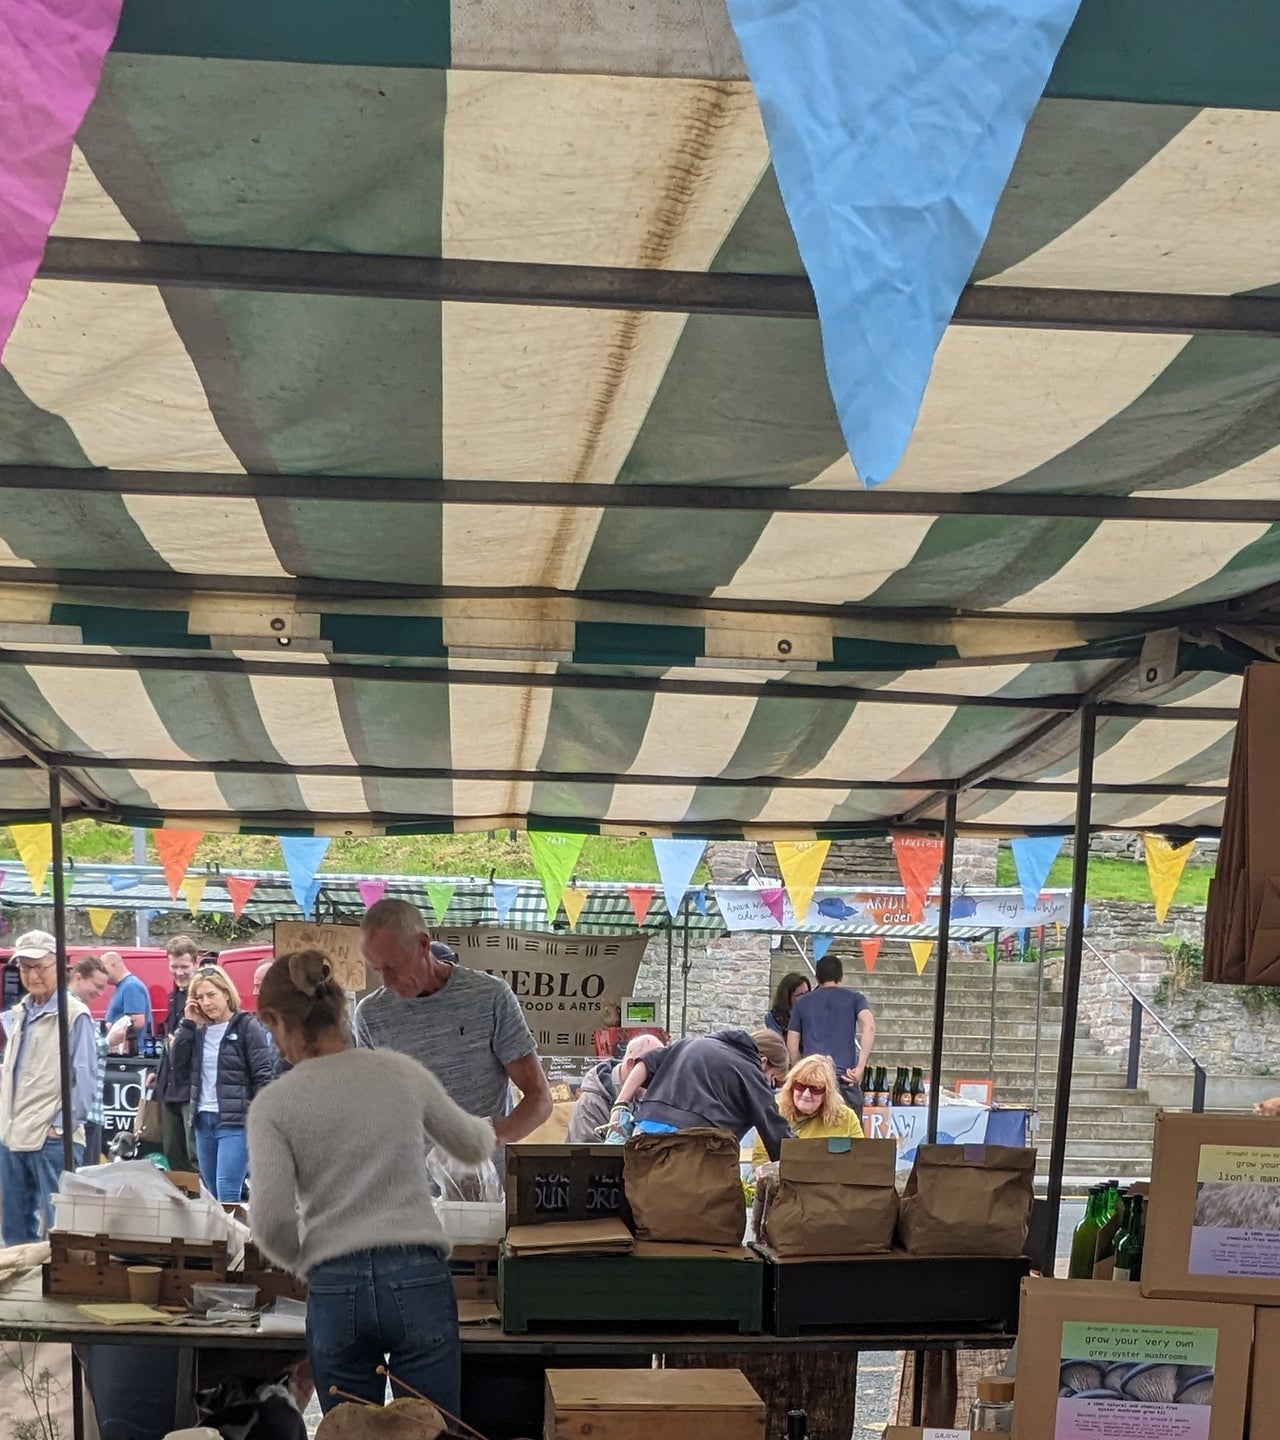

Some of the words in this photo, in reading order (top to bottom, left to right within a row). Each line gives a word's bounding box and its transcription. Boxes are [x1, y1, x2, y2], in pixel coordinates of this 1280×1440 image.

[883, 909, 914, 923] cider
[558, 1002, 565, 1011] &
[570, 1002, 601, 1011] ARTS
[1218, 1172, 1254, 1182] lion's
[1085, 1336, 1110, 1344] grow
[1115, 1337, 1138, 1346] your
[1145, 1339, 1169, 1348] very
[1176, 1340, 1194, 1348] own
[1089, 1349, 1107, 1357] grey
